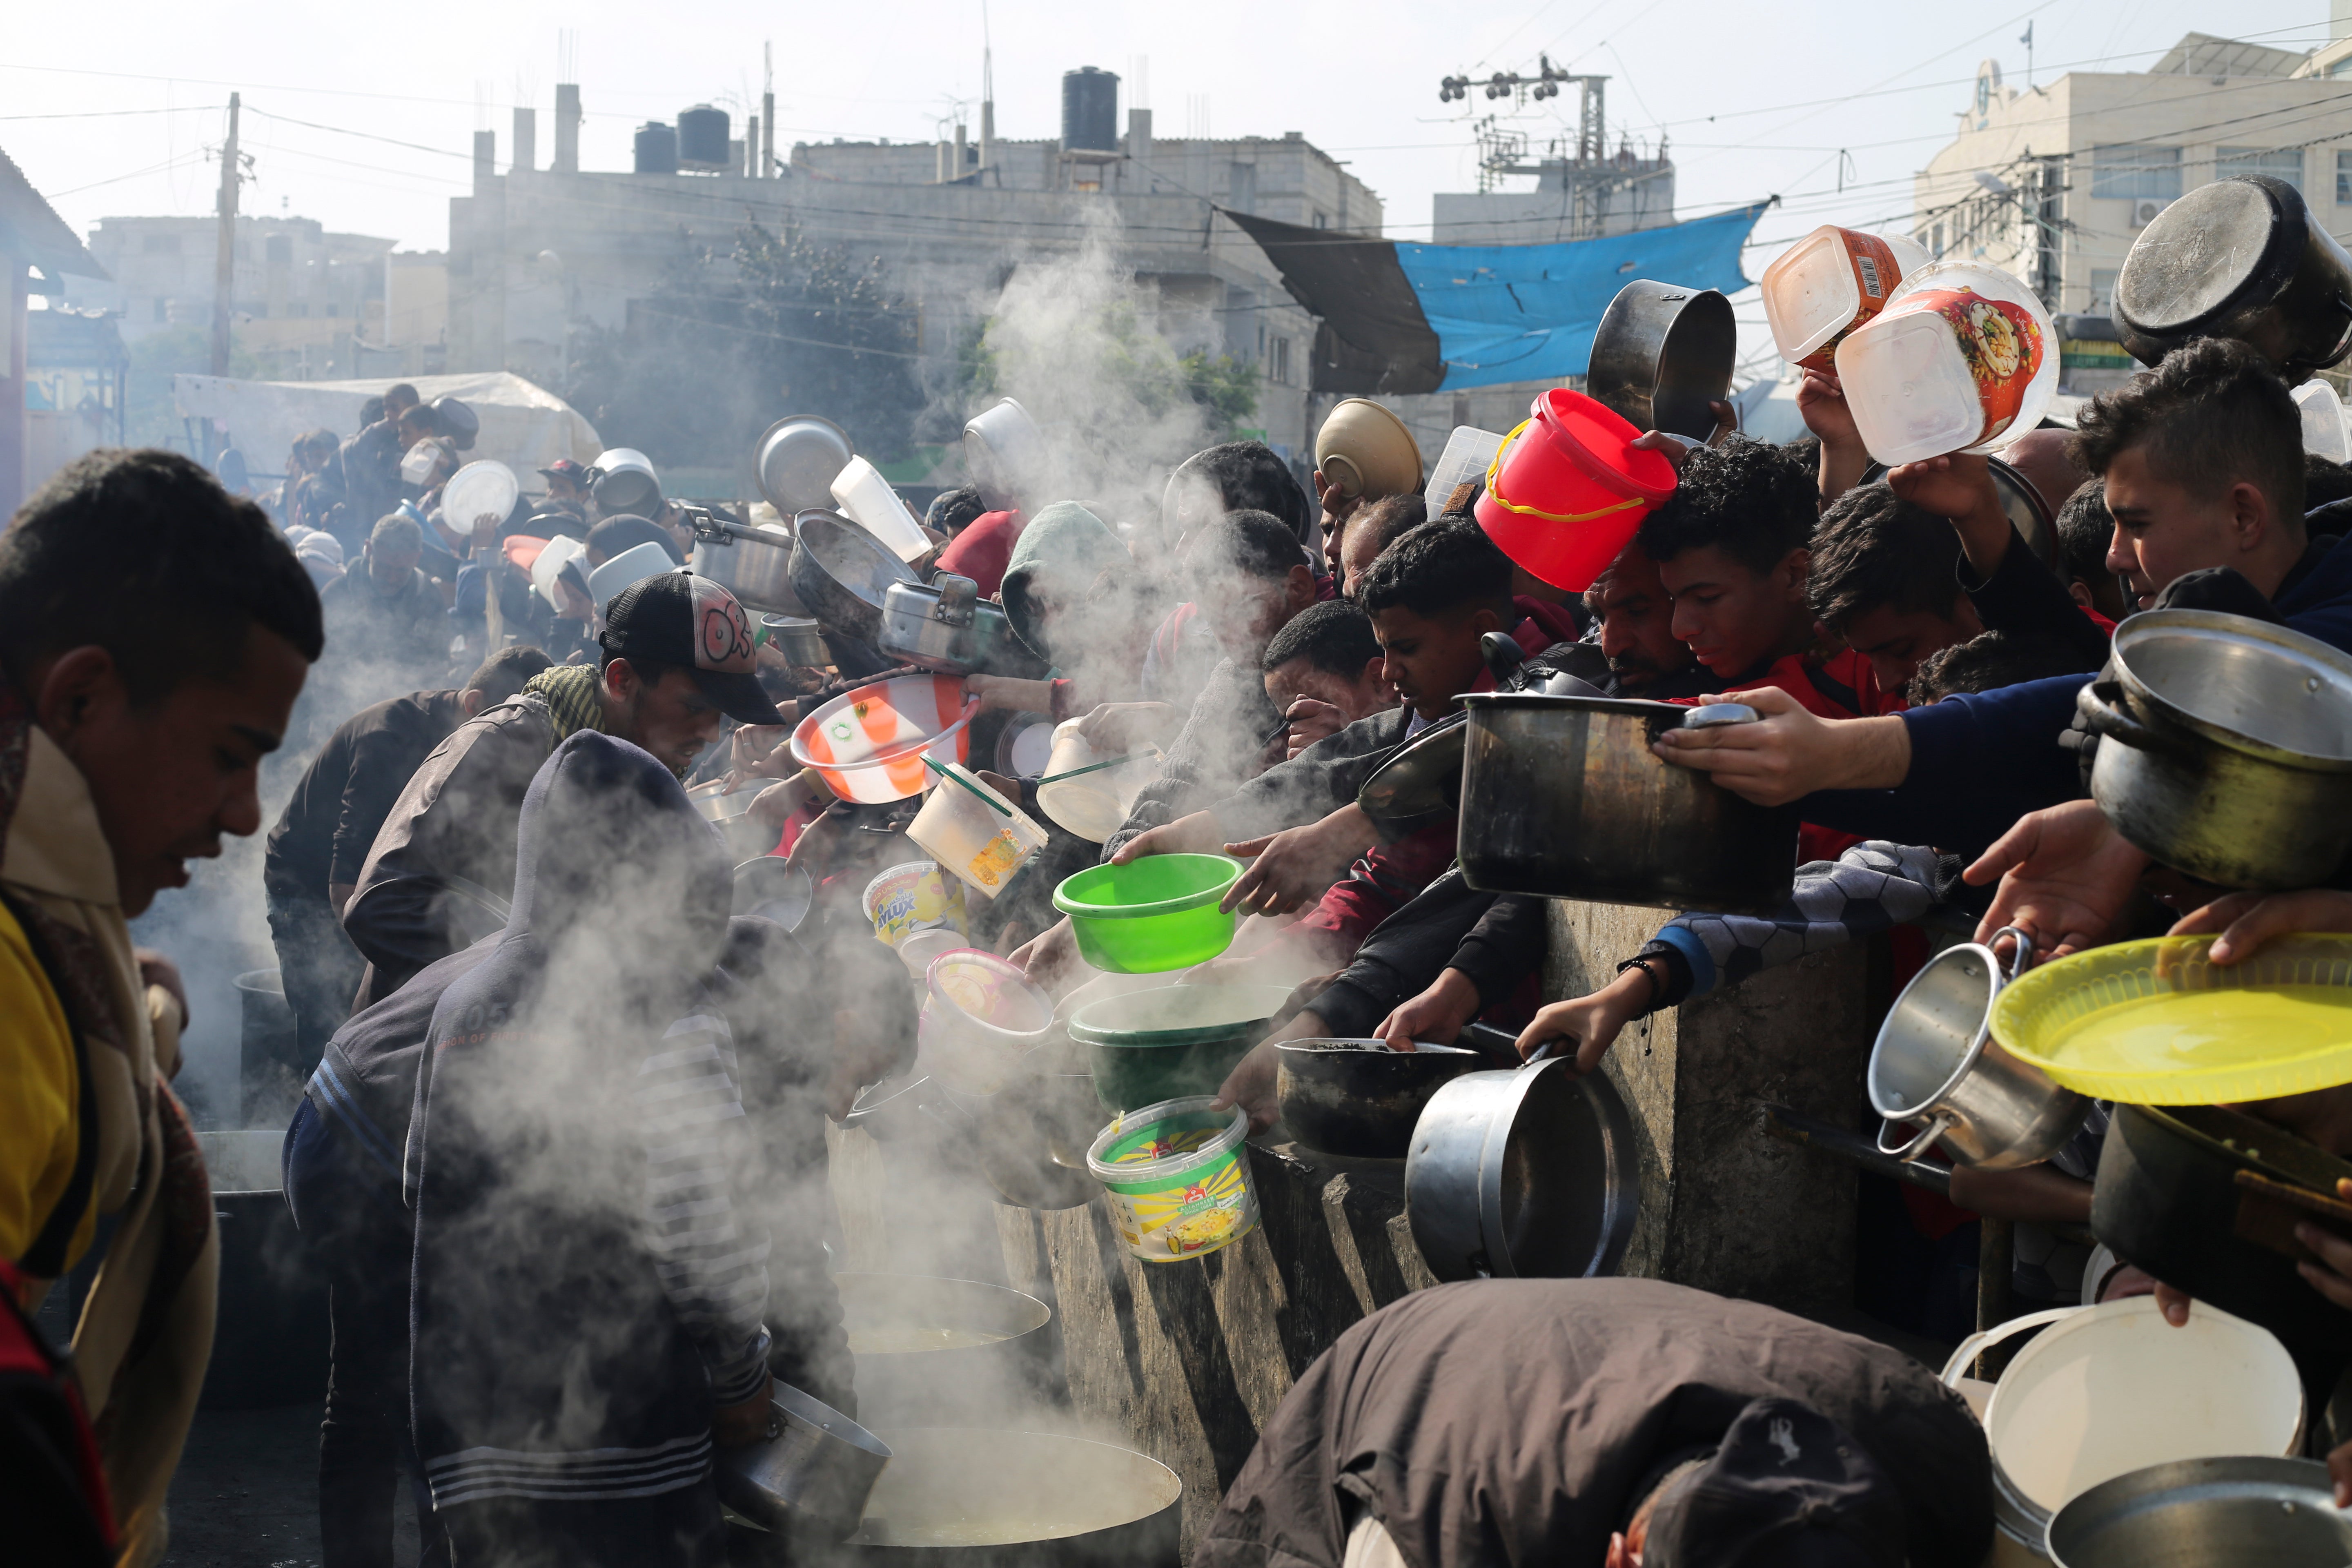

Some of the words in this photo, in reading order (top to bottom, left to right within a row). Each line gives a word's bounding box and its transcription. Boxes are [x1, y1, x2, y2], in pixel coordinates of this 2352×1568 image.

[882, 879, 911, 893] معجون
[878, 898, 915, 933] AYLUX
[470, 1033, 486, 1043] OF
[491, 1032, 527, 1041] FIRST
